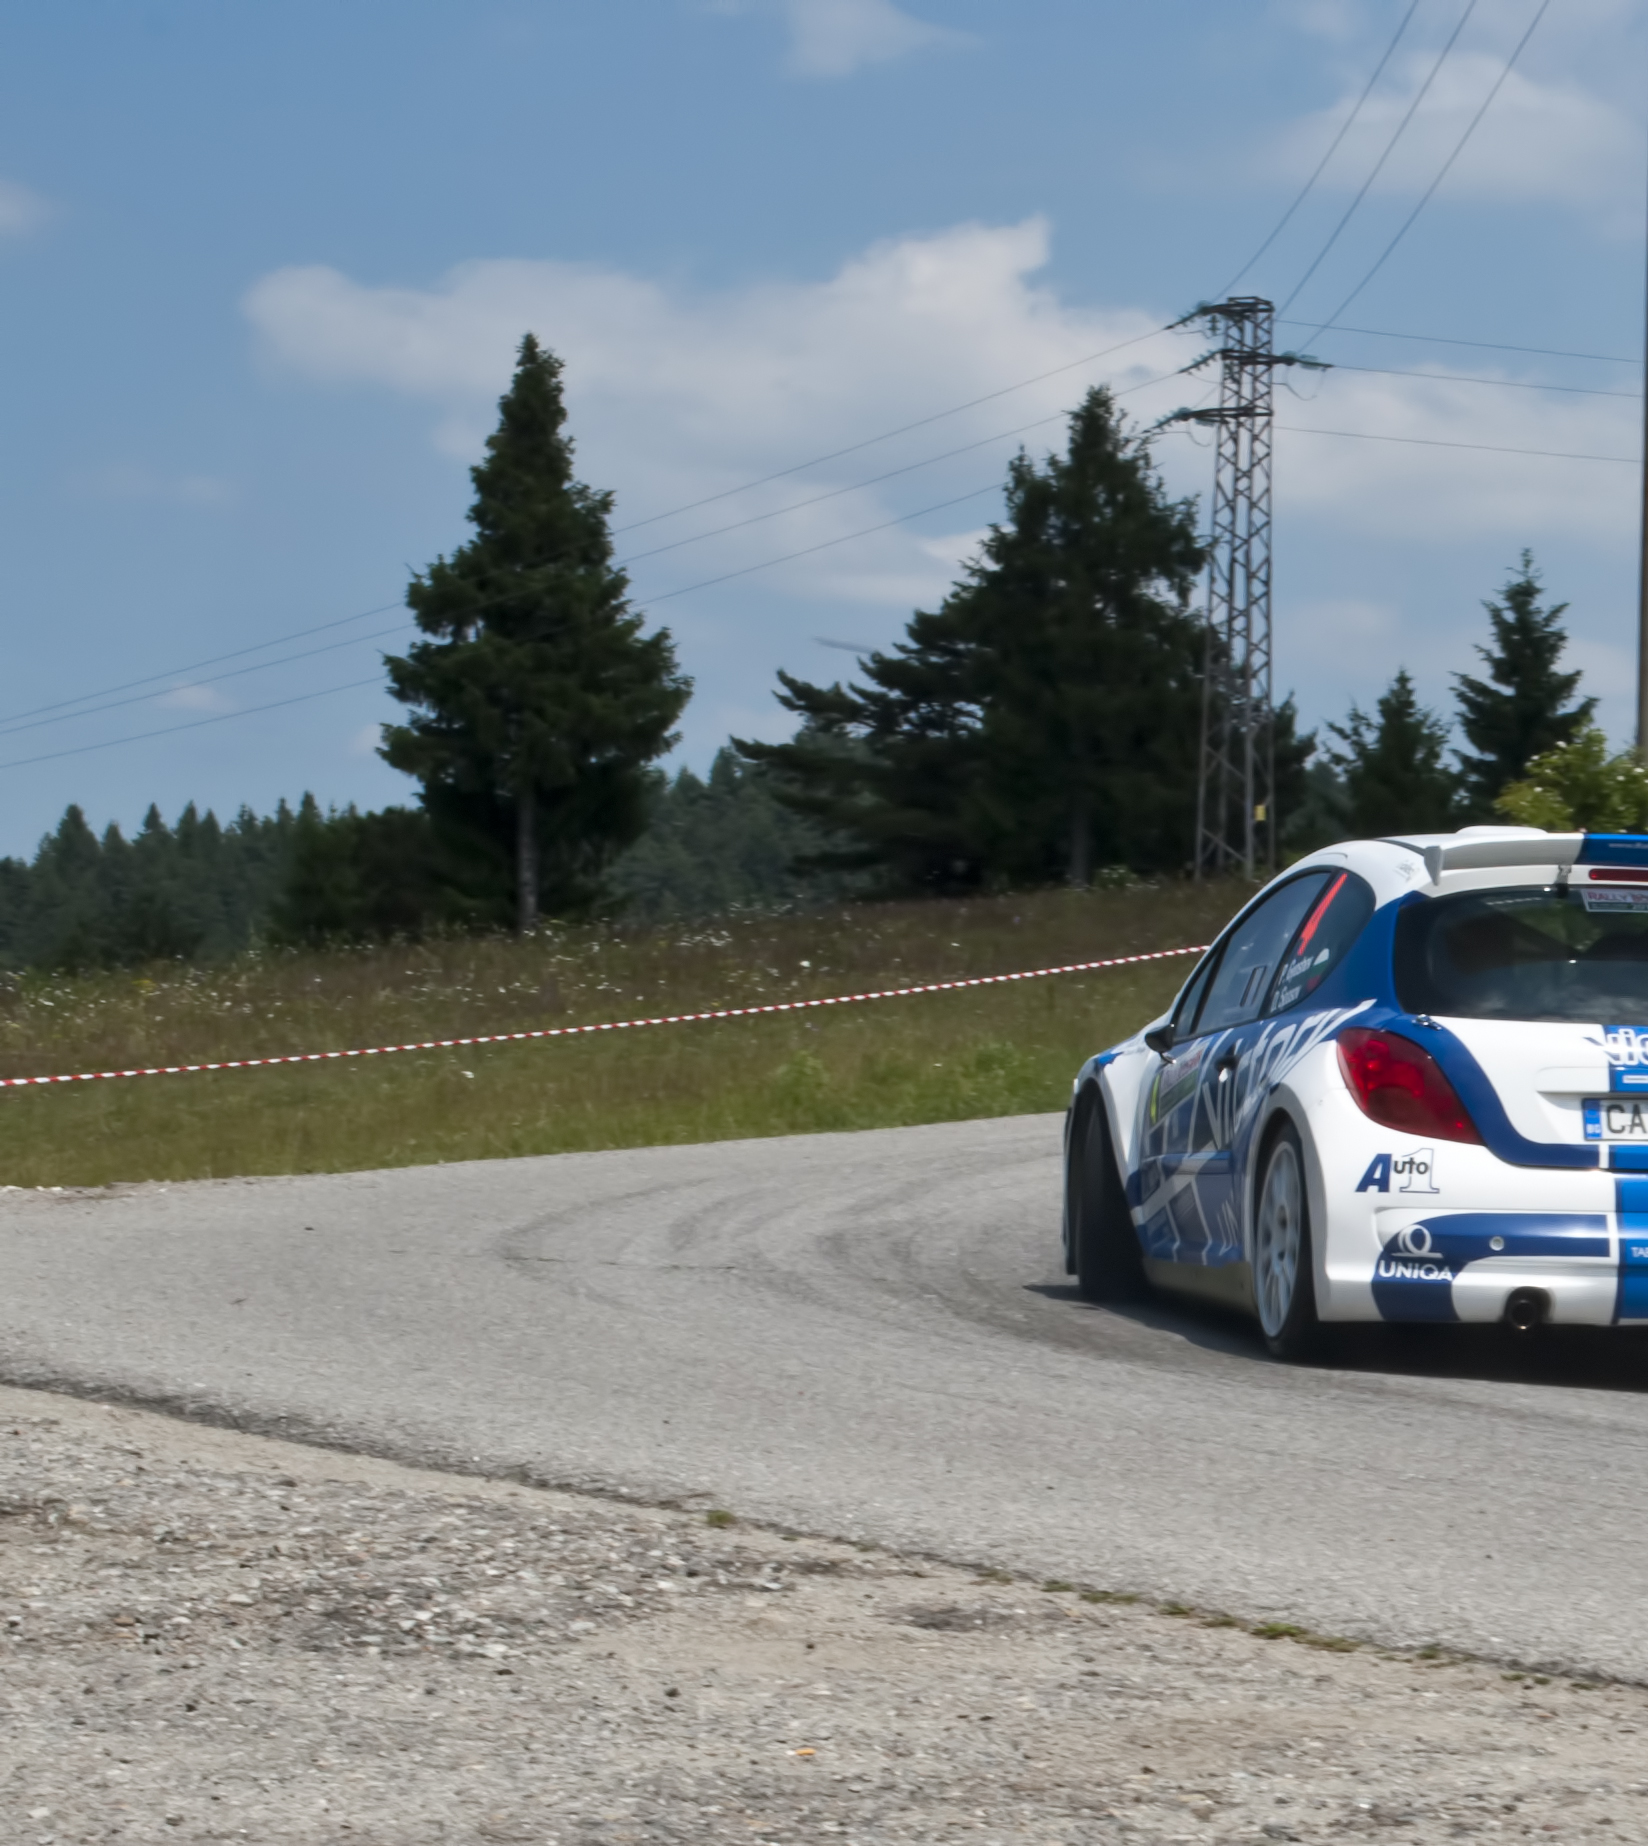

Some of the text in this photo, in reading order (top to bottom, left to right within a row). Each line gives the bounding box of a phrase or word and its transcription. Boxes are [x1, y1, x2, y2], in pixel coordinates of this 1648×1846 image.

[1297, 872, 1349, 957] 4
[1606, 1104, 1647, 1135] CA
[1378, 1260, 1454, 1282] UNIQA
